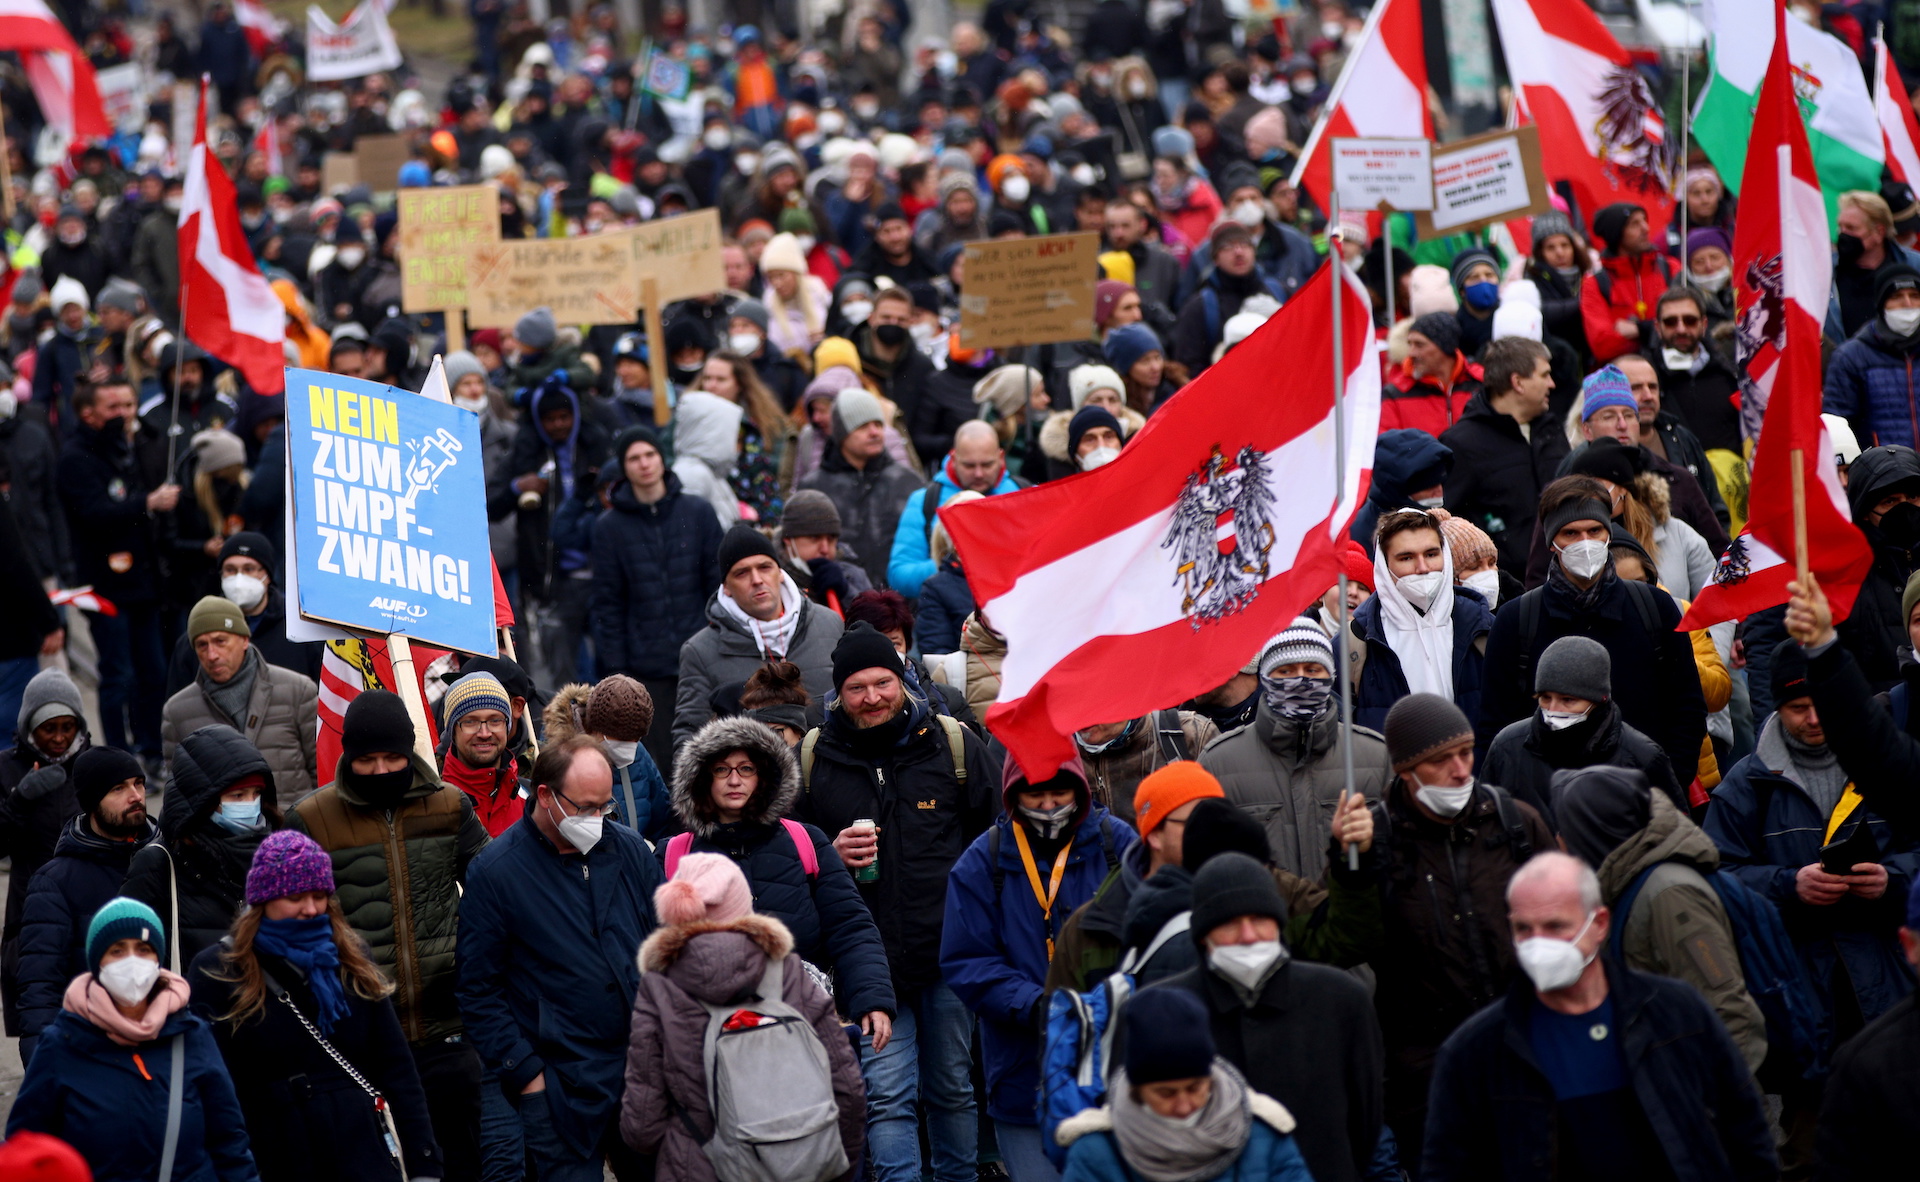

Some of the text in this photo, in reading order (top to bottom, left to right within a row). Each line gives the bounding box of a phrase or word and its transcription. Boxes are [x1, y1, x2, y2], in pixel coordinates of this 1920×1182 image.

[405, 193, 484, 224] FREIE
[308, 385, 399, 445] NEIN
[311, 431, 402, 493] ZUM
[314, 478, 433, 541] IMPF-
[317, 526, 472, 605] ZWANG!
